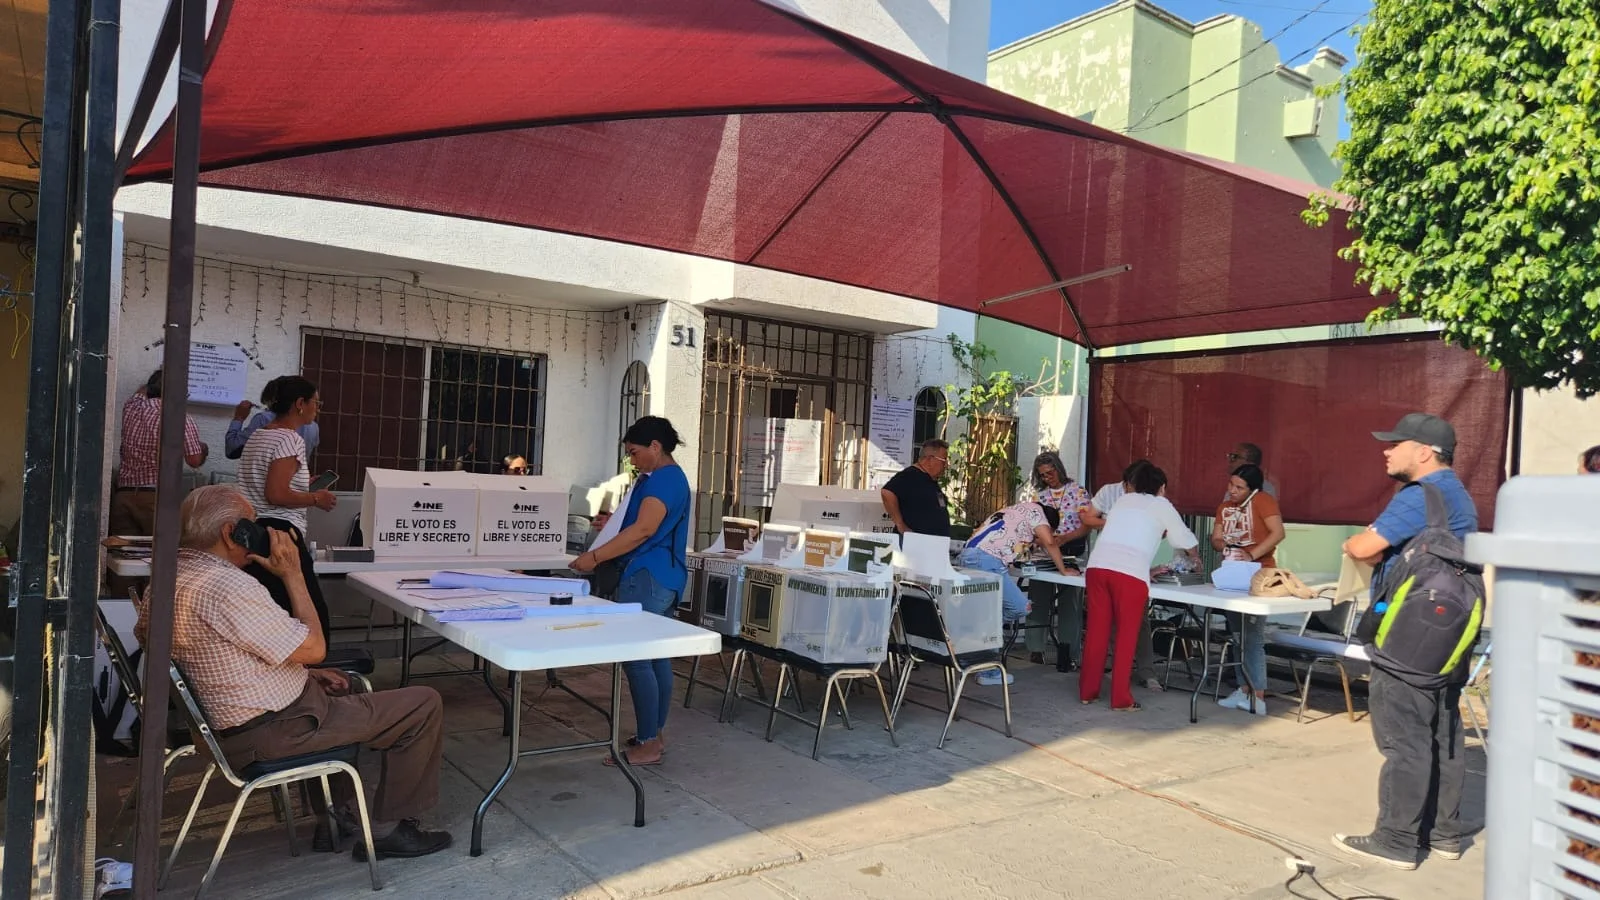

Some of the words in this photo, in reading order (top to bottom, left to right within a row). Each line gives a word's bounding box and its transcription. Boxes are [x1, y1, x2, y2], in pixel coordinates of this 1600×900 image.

[671, 324, 695, 348] 51
[521, 504, 539, 512] INE
[396, 519, 409, 529] EL
[412, 519, 440, 529] VOTO
[443, 519, 457, 530] ES
[497, 520, 509, 530] EL
[512, 520, 537, 530] VOTO
[539, 521, 551, 530] ES
[379, 532, 410, 542] LIBRE
[413, 532, 420, 541] Y
[422, 532, 471, 543] SECRETO
[483, 532, 510, 542] LIBRE
[513, 533, 519, 541] Y
[520, 533, 562, 543] SECRETO
[788, 578, 827, 597] AYUNTAMIENTO
[836, 587, 889, 599] AYUNTAMIENTO
[951, 582, 1000, 595] AYUNTAMIENTO
